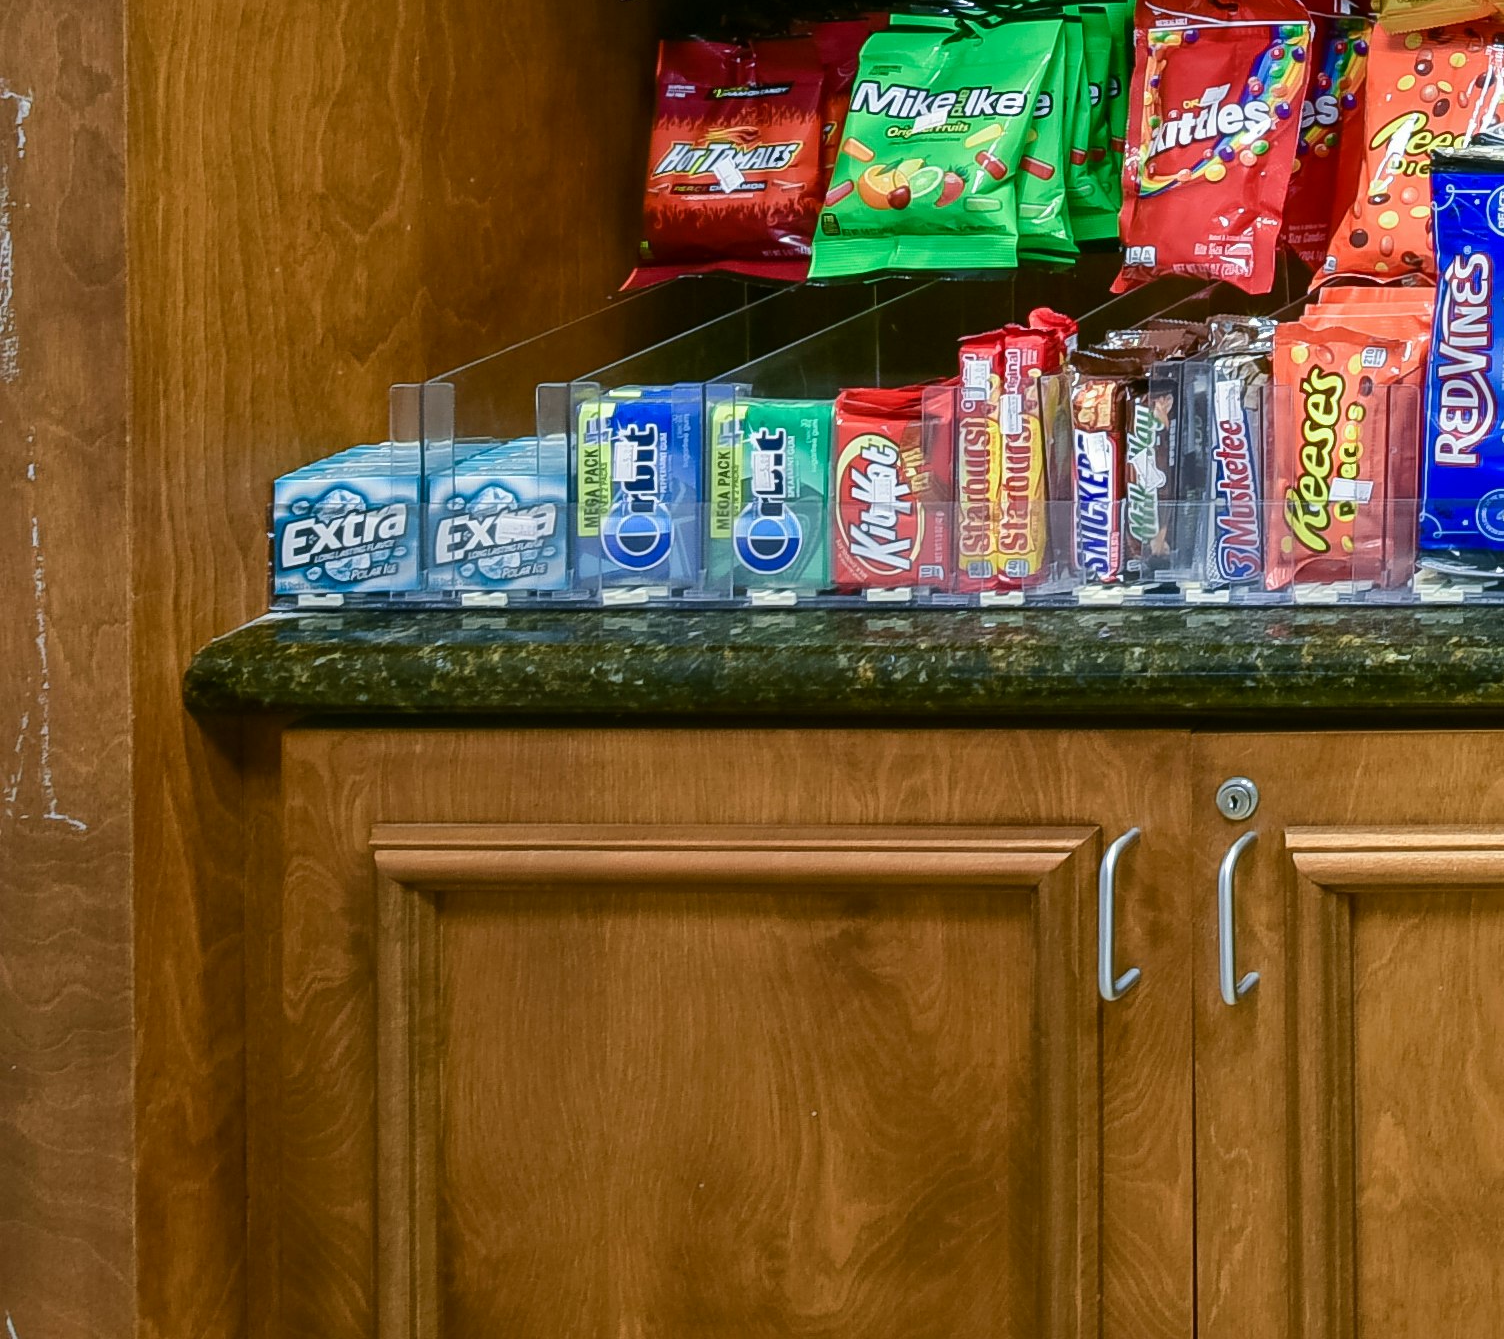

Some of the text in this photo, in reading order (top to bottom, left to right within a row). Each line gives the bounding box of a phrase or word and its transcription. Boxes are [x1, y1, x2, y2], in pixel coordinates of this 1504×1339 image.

[852, 82, 1030, 122] Mike Ike
[584, 450, 598, 530] MEGA PACK
[282, 502, 408, 568] Extra
